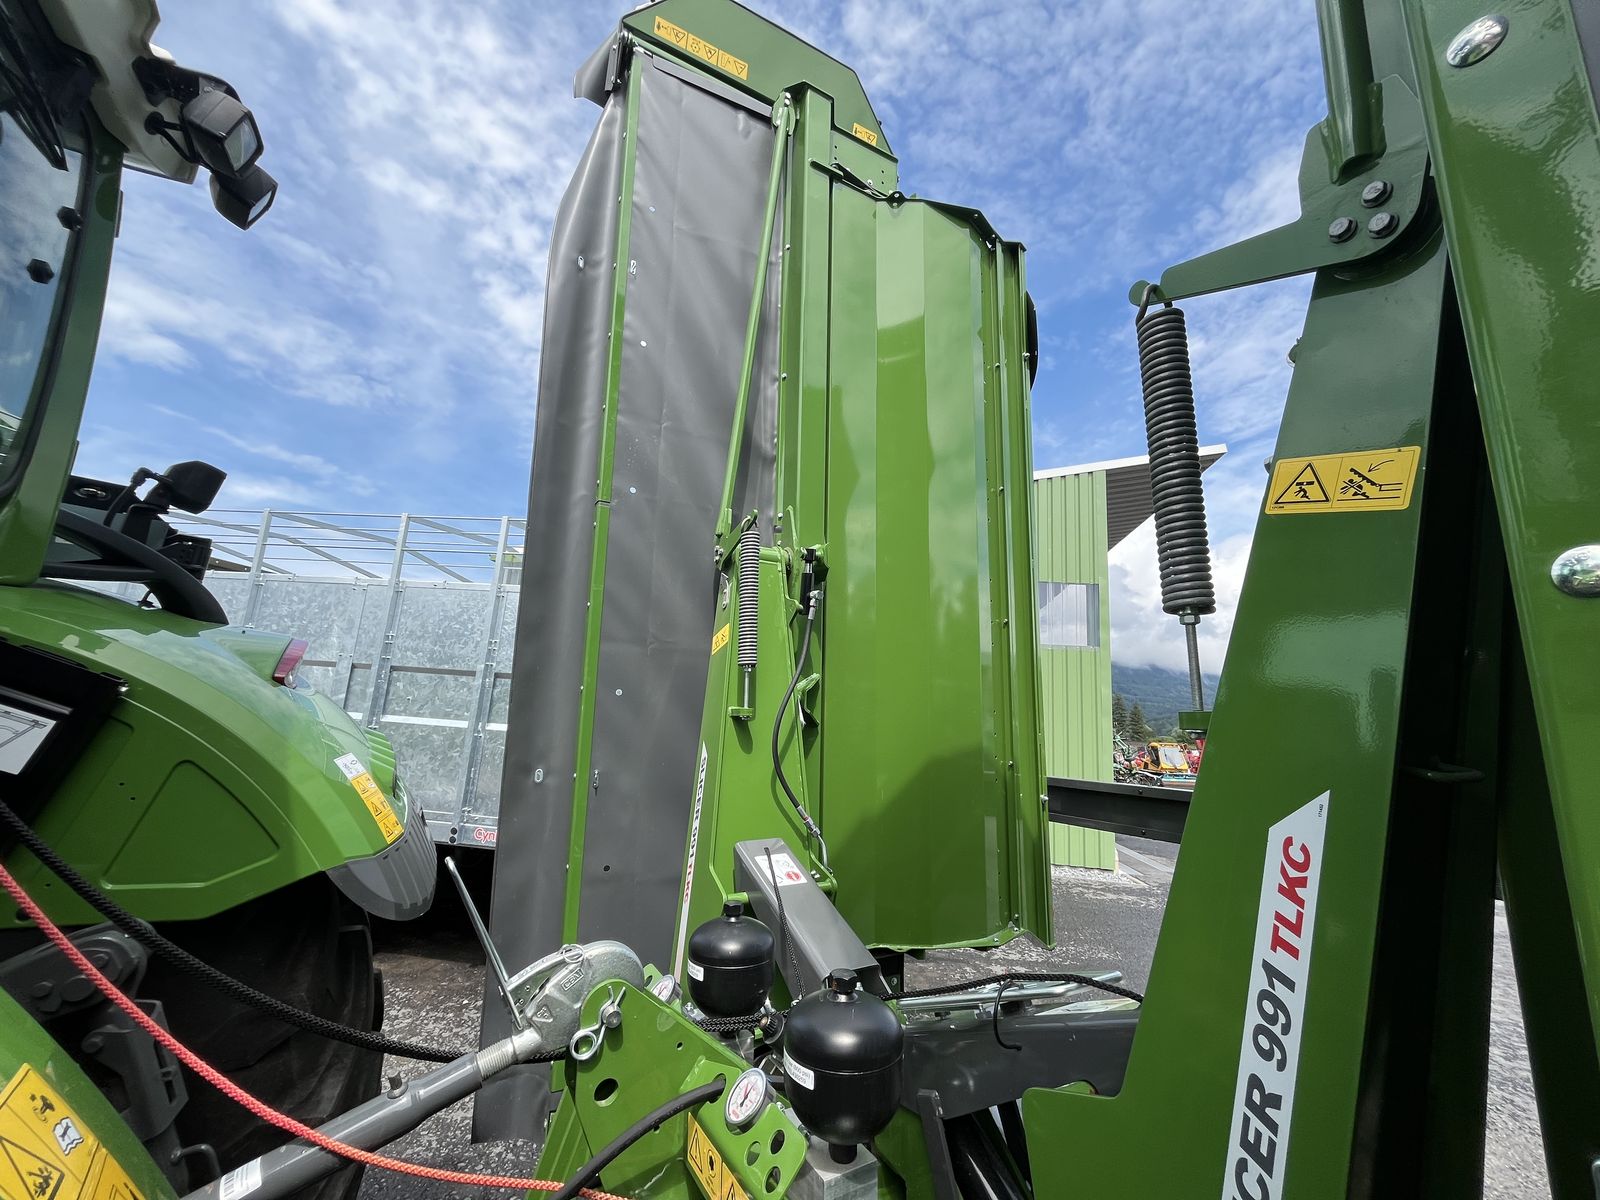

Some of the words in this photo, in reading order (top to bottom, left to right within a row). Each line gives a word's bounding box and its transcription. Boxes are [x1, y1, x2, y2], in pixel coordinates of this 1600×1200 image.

[695, 756, 706, 820] SLICER
[1270, 836, 1311, 961] TLKC
[1252, 958, 1296, 1072] 991
[1232, 1073, 1283, 1200] CER
